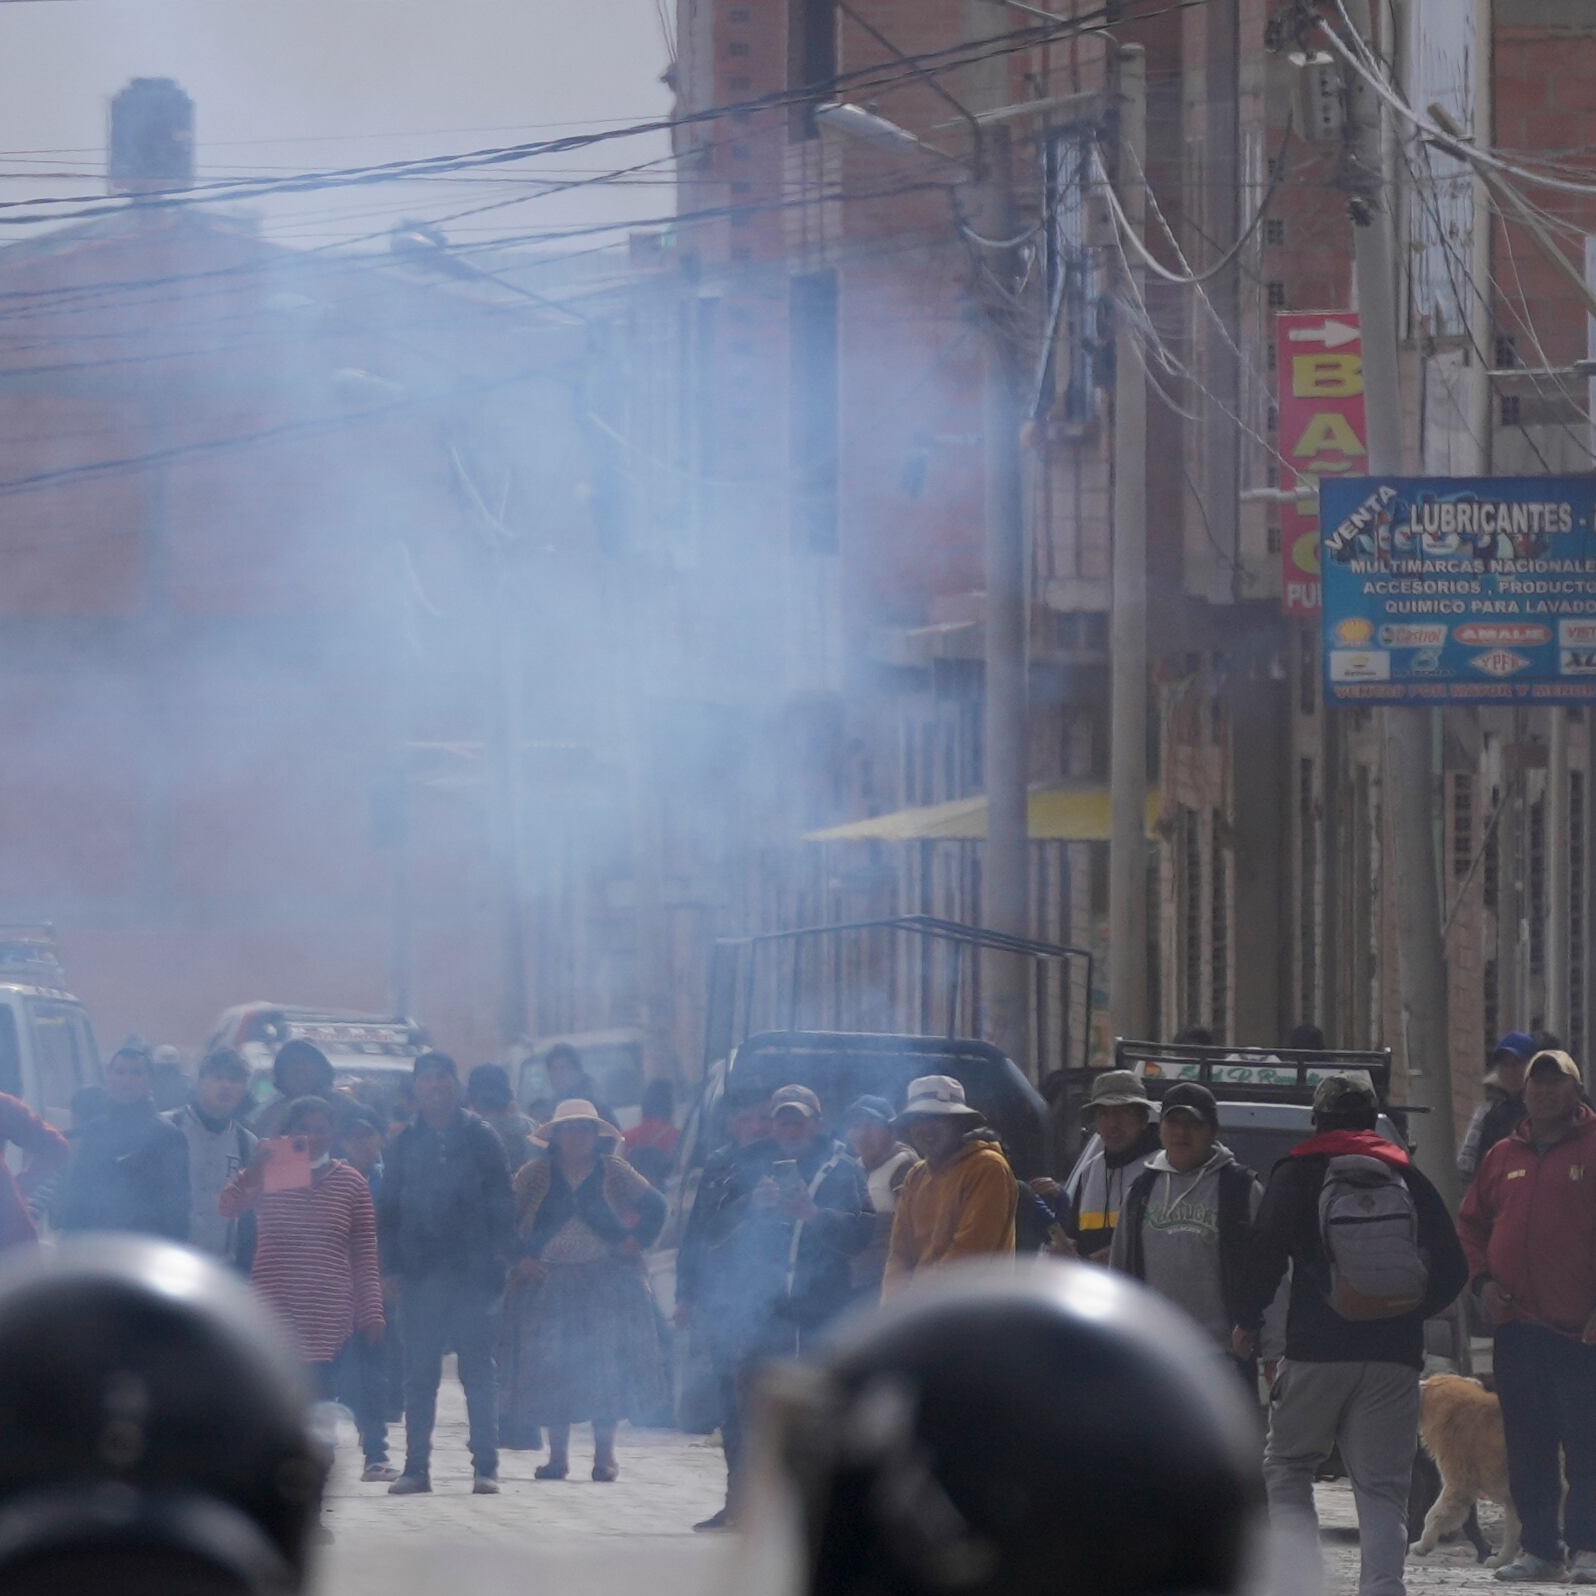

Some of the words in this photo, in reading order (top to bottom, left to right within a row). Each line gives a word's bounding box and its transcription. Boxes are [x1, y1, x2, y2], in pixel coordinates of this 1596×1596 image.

[1324, 485, 1397, 550] VENTA
[1410, 502, 1572, 534] LUBRICANTES
[1351, 559, 1485, 574] MULTIMARCAS
[1490, 559, 1596, 573] NACIONALE
[1363, 580, 1481, 595] ACCESORIOS
[1385, 600, 1466, 614] QUIMICO
[1470, 600, 1520, 614] PARA
